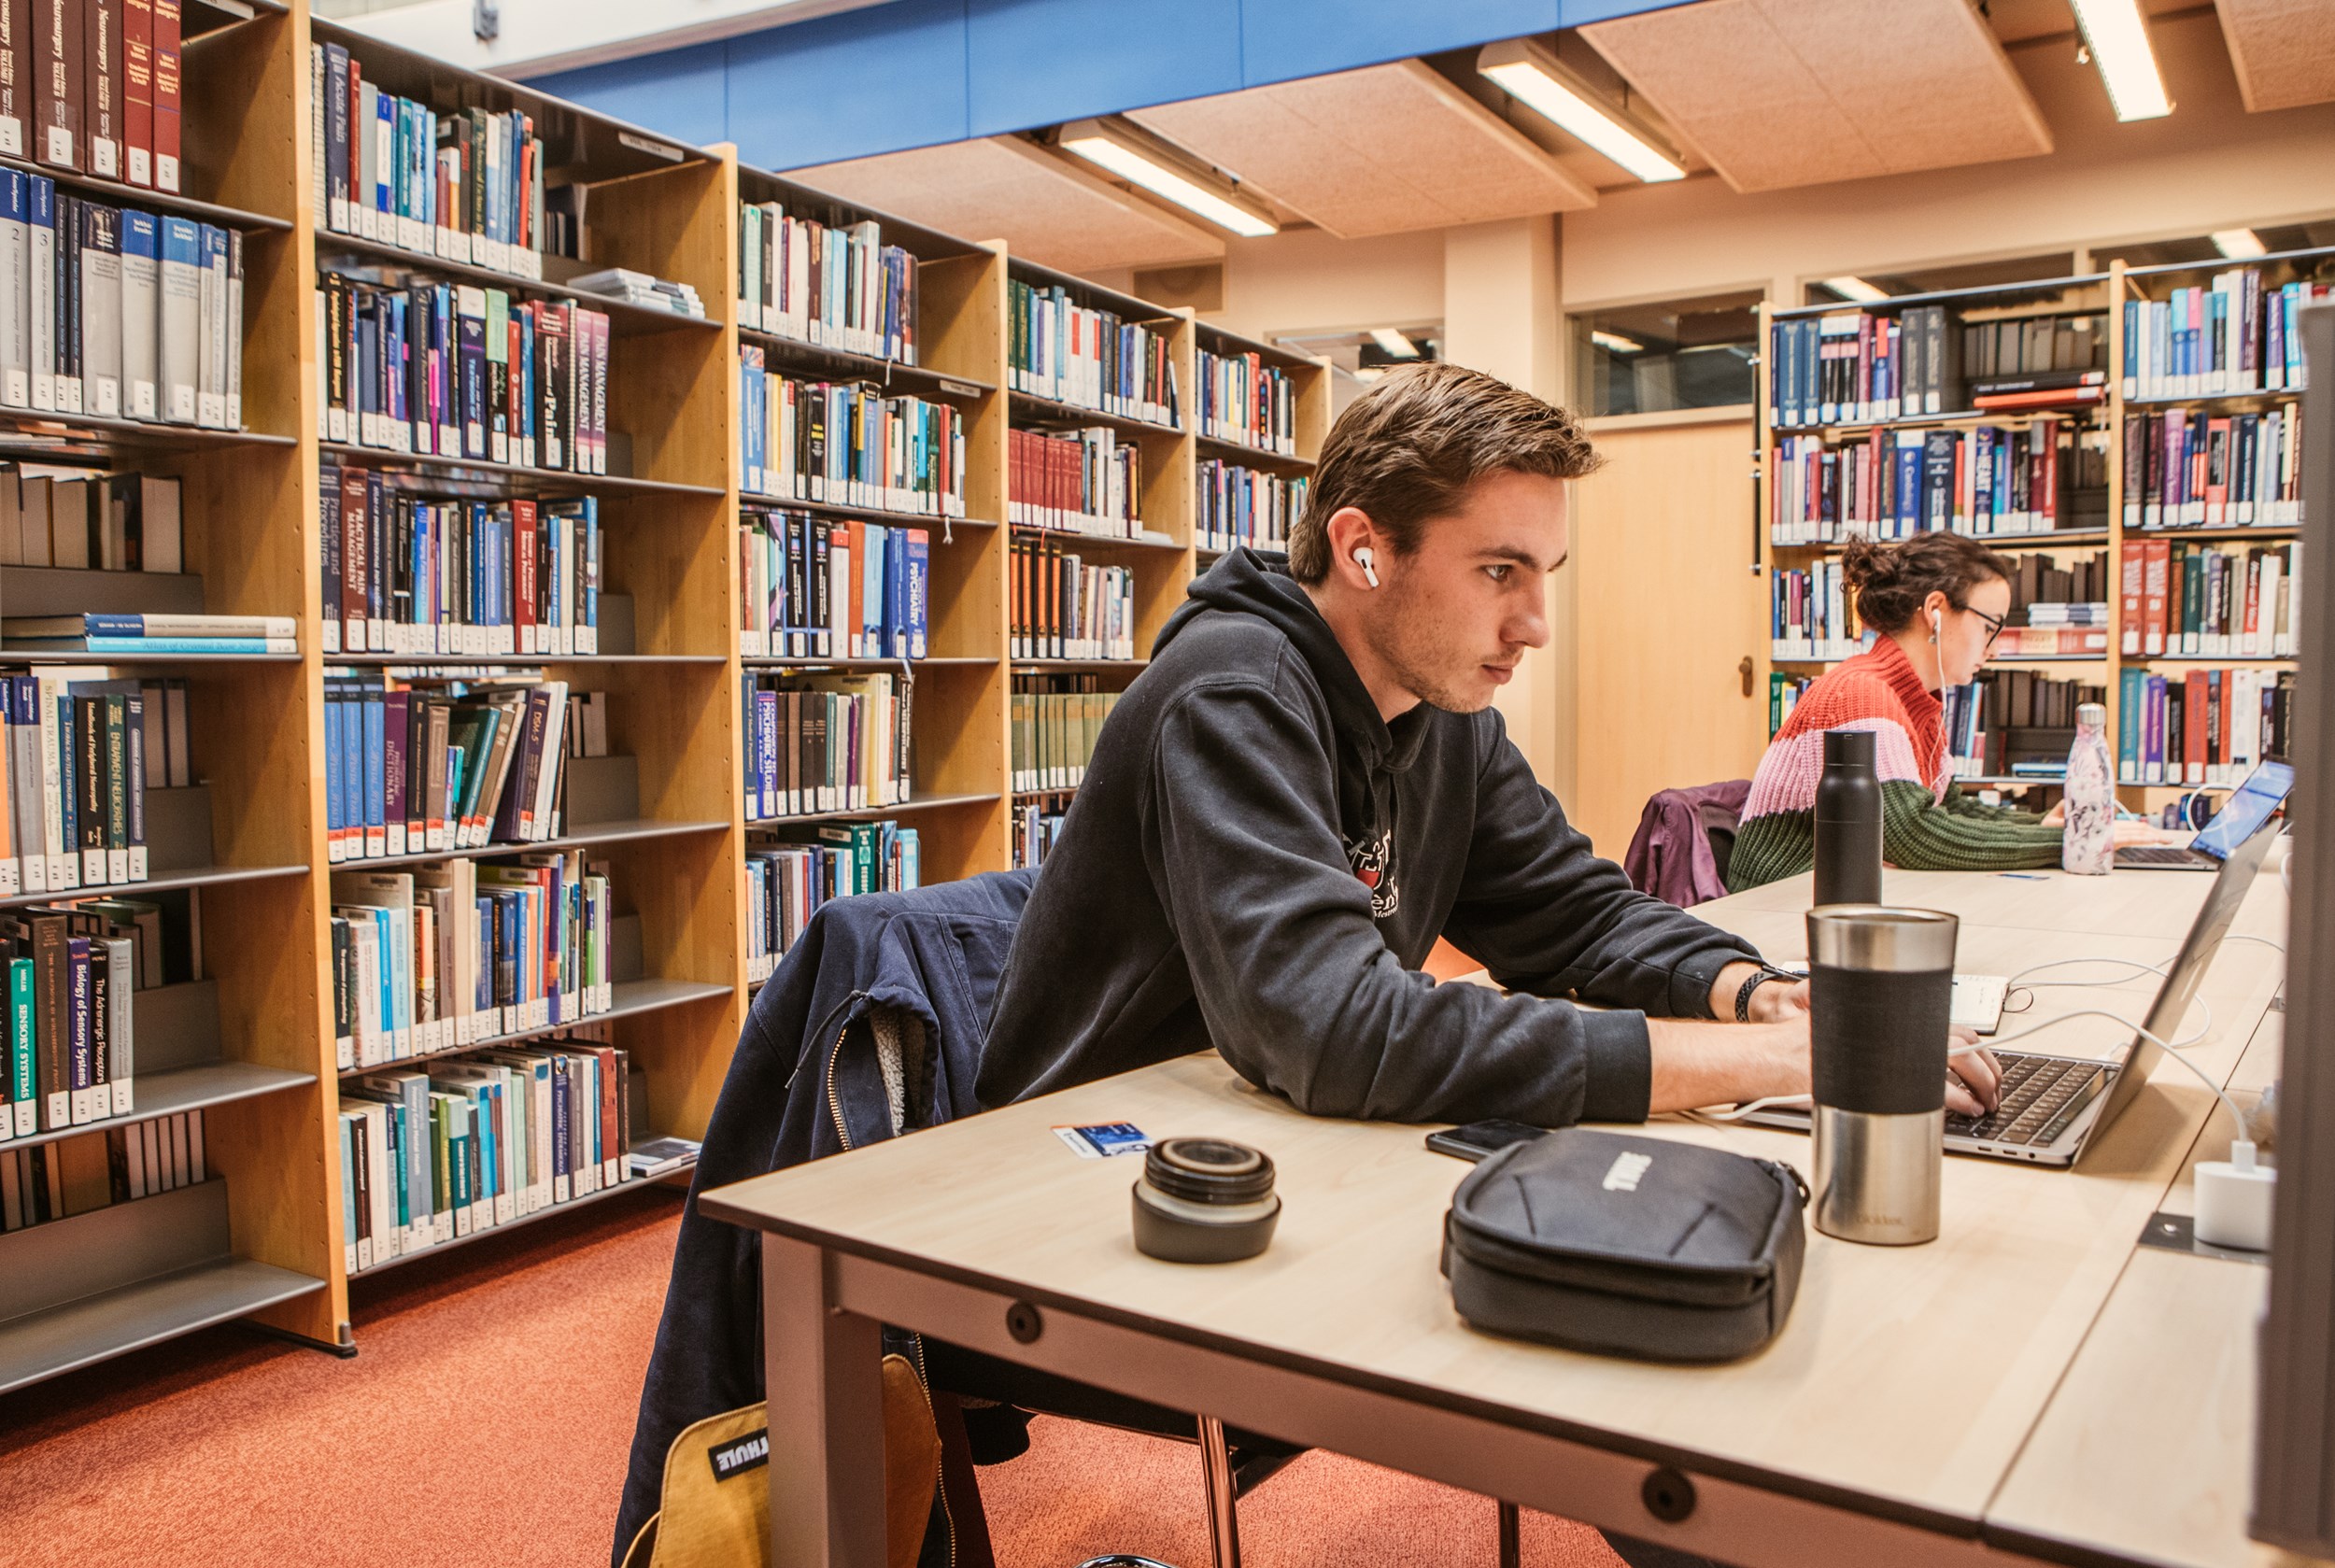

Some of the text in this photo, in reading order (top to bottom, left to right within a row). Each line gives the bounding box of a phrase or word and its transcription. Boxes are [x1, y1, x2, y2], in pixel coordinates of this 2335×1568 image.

[1, 0, 11, 46] rosurgery
[97, 8, 109, 73] Neurosurgery
[335, 76, 347, 142] Acute Pain
[12, 229, 21, 241] 2
[39, 233, 49, 246] 3
[544, 396, 556, 438] Pain
[579, 331, 589, 430] PAIN MANAGEMENT
[595, 335, 605, 433] PAIN MANAGEMENT
[320, 497, 330, 566] Procedures
[331, 497, 340, 575] Practice and
[347, 512, 356, 590] MANAGEMENT
[356, 508, 365, 595] PRACTICAL PAIN
[44, 685, 55, 766] SPINAL TRAUMA
[763, 701, 771, 793] PSYCHIATRIC STUDIE
[110, 732, 122, 834] ENTRAPMENT NEUROPATHIES
[19, 1003, 30, 1097] SENSORY SYSTEMS
[75, 964, 87, 1085] Biology of Sensory Systems
[93, 979, 105, 1082] The Adrenergic Receptors
[716, 1435, 769, 1472] THULE
